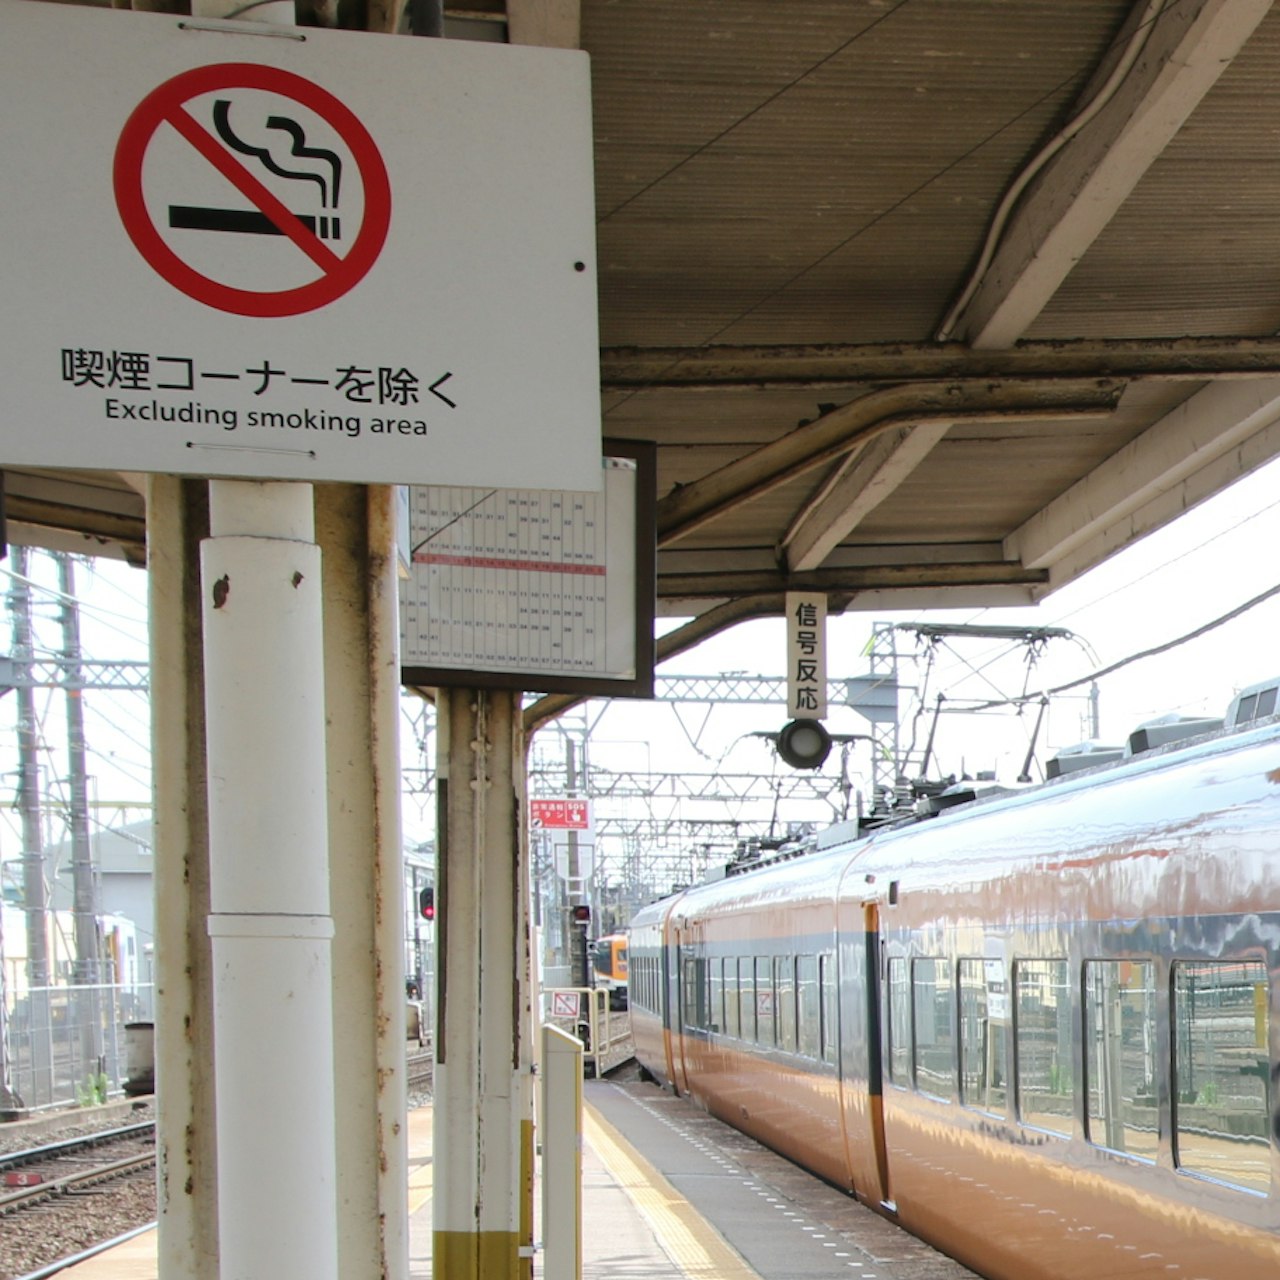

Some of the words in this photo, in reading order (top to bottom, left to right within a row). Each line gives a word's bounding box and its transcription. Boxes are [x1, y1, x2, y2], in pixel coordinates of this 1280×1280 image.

[60, 347, 457, 410] 喫煙コーナーを除く
[104, 398, 239, 431] Excluding
[247, 408, 361, 437] smoking
[370, 417, 428, 436] area
[795, 602, 818, 711] 信号反応
[17, 1174, 28, 1186] 3
